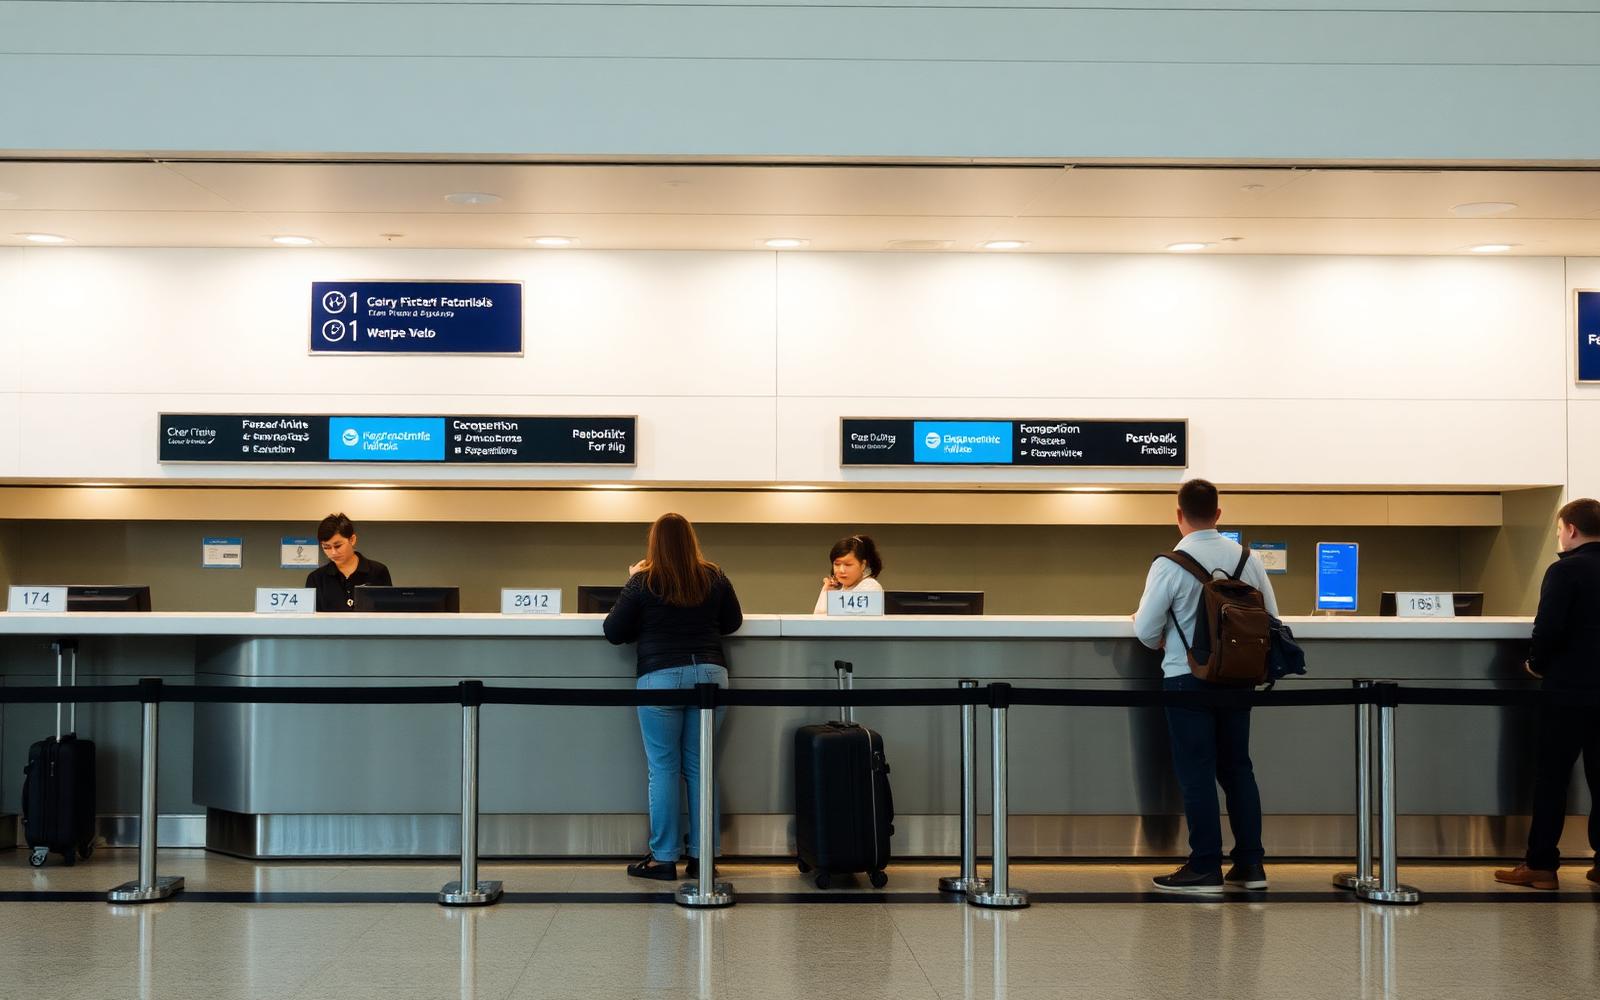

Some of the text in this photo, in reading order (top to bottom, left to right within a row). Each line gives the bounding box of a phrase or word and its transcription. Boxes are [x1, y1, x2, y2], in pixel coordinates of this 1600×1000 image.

[349, 292, 358, 314] 1
[349, 320, 357, 342] 1
[24, 592, 50, 605] 174
